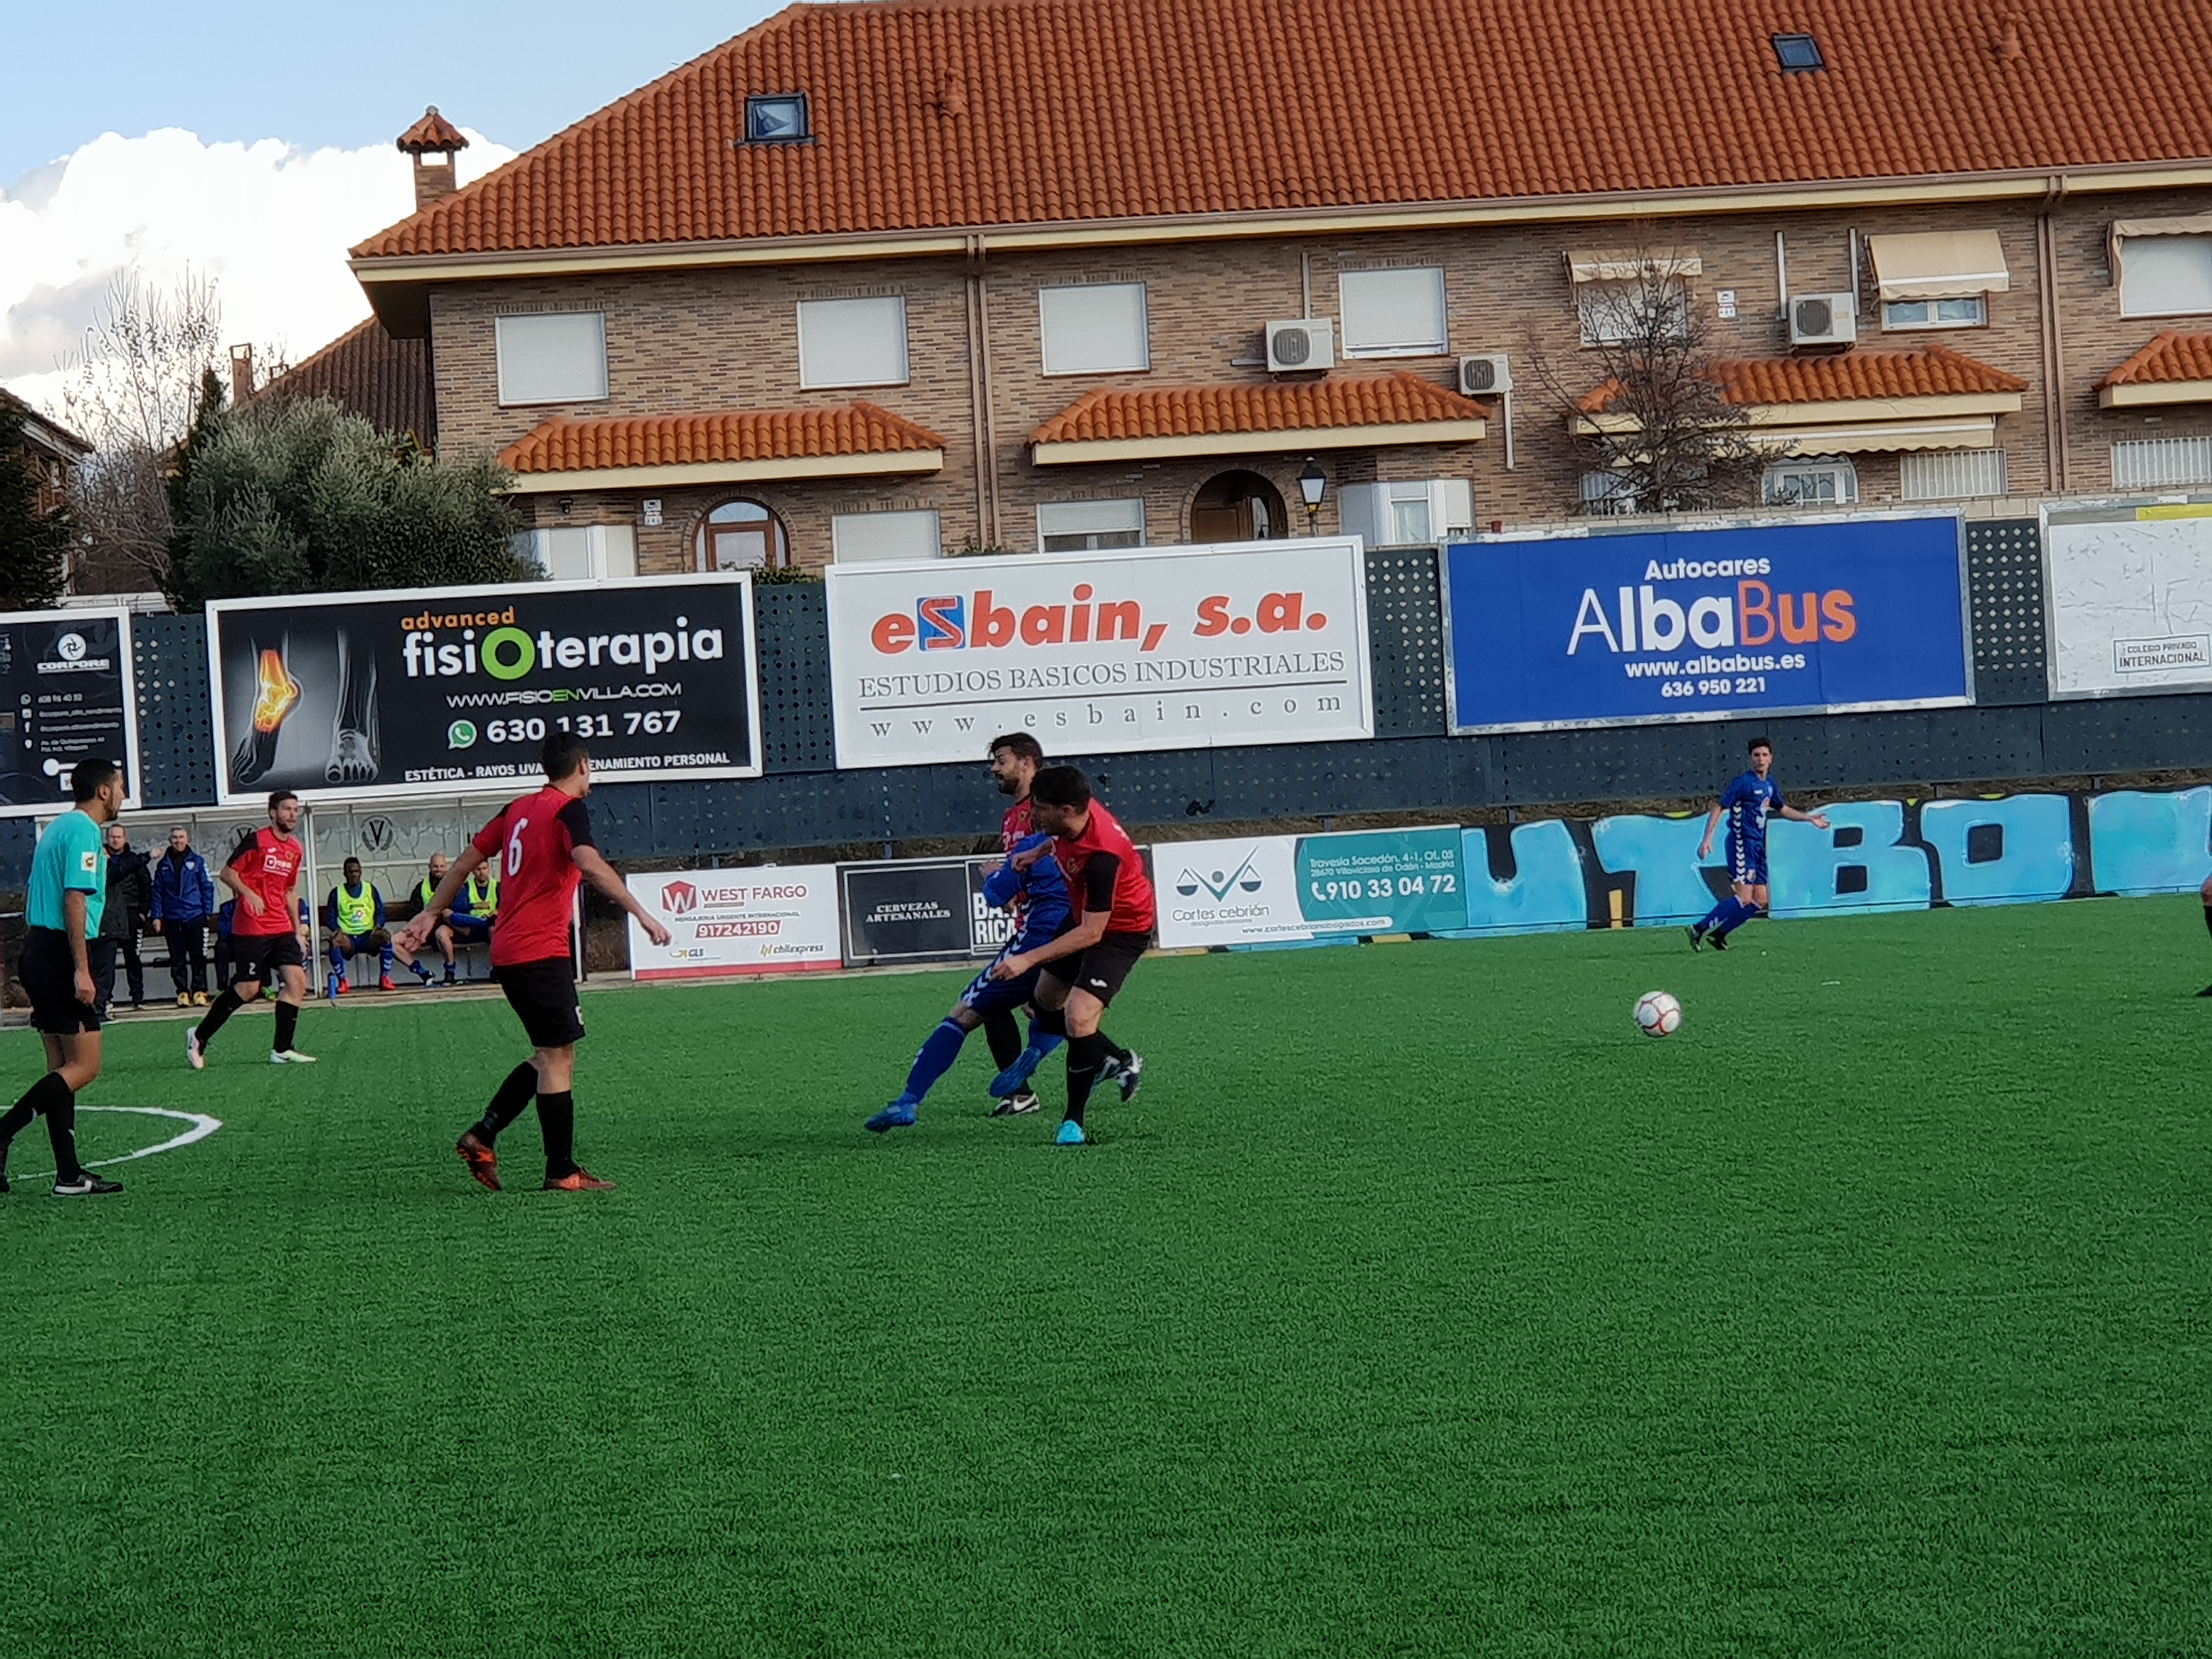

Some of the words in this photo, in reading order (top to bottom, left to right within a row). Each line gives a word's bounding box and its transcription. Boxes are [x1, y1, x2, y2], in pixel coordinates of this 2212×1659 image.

[1644, 556, 1771, 580] Autocares
[400, 605, 515, 630] advanced
[1193, 591, 1328, 636] s.a.
[1566, 579, 1858, 656] AlbaBus
[1624, 652, 1806, 678] www.albabus.es
[2119, 651, 2207, 668] INTERNACIONAL
[857, 668, 1002, 699] ESTUDIOS
[1008, 661, 1127, 690] BASICOS
[1134, 651, 1345, 682] INDUSTRIALES
[1661, 681, 1695, 698] 636
[1698, 679, 1732, 696] 950
[1735, 676, 1767, 693] 221
[445, 682, 682, 709] WWW.FISIOENVILLA.COM
[487, 717, 546, 743] 630
[556, 714, 613, 739] 131
[623, 710, 681, 735] 767
[404, 766, 465, 782] ESTÉTICA
[476, 764, 515, 777] RAYOS
[518, 762, 544, 775] UVA
[589, 754, 660, 770] ENAMIENTO
[664, 752, 731, 766] PERSONAL
[507, 817, 528, 877] 6
[701, 888, 748, 902] WEST
[752, 885, 808, 900] FARGO
[1325, 879, 1362, 901] 910
[1368, 879, 1392, 898] 33
[1398, 877, 1425, 896] 04
[1430, 874, 1457, 894] 72
[865, 909, 951, 923] ARTESANALES
[876, 901, 939, 913] CERVEZAS
[1172, 909, 1215, 922] Cortes
[1218, 904, 1270, 919] cebrián
[698, 922, 778, 937] 917242190
[249, 962, 256, 975] 2
